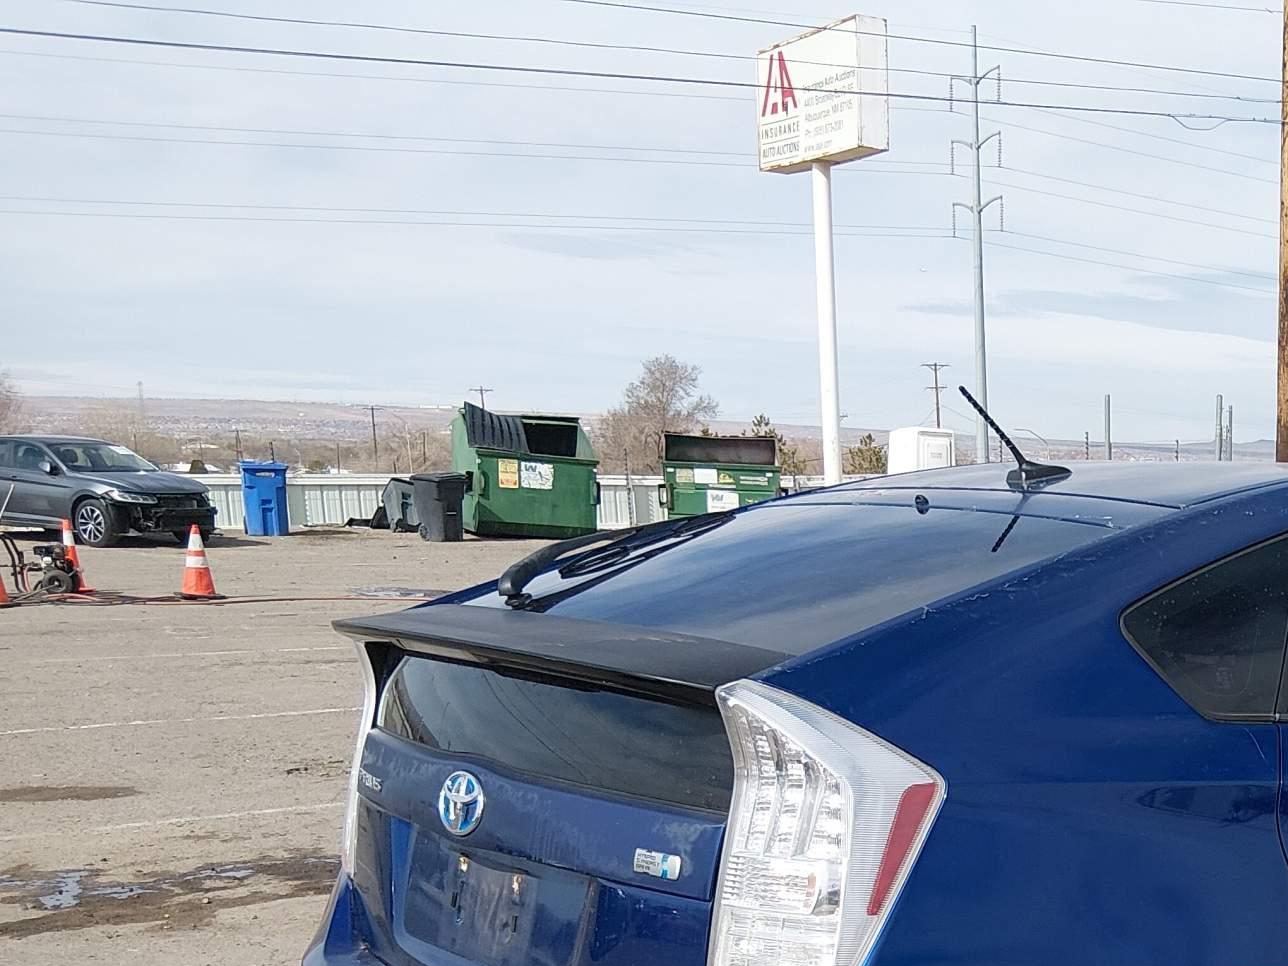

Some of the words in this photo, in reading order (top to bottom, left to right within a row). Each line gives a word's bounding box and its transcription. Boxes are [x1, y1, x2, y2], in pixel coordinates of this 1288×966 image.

[761, 121, 799, 139] INSURANCE
[762, 146, 776, 158] AUTO
[776, 141, 799, 155] AUCTIONS
